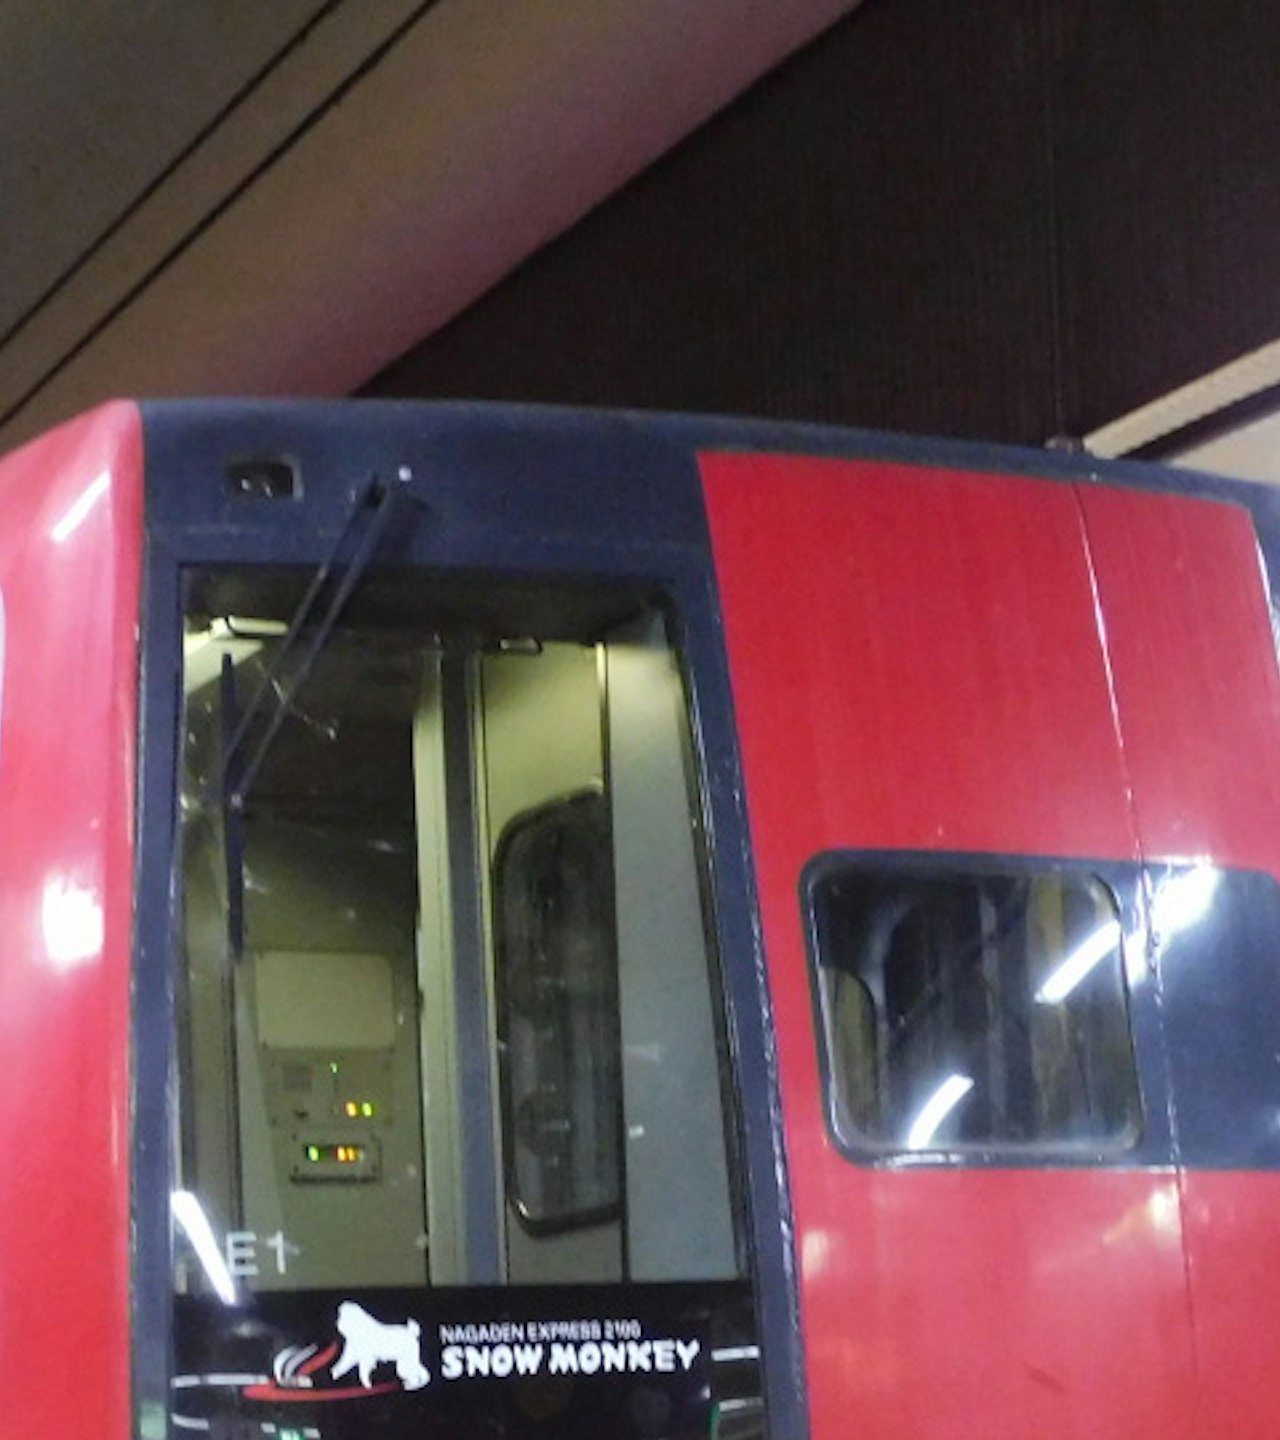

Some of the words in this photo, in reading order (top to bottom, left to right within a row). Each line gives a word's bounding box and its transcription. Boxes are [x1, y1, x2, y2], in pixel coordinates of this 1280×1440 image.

[438, 1324, 524, 1345] NAGADEN
[527, 1321, 601, 1343] EXPRESS
[604, 1319, 642, 1341] 2100
[441, 1343, 543, 1379] SNOW
[549, 1338, 701, 1375] MONKEY
